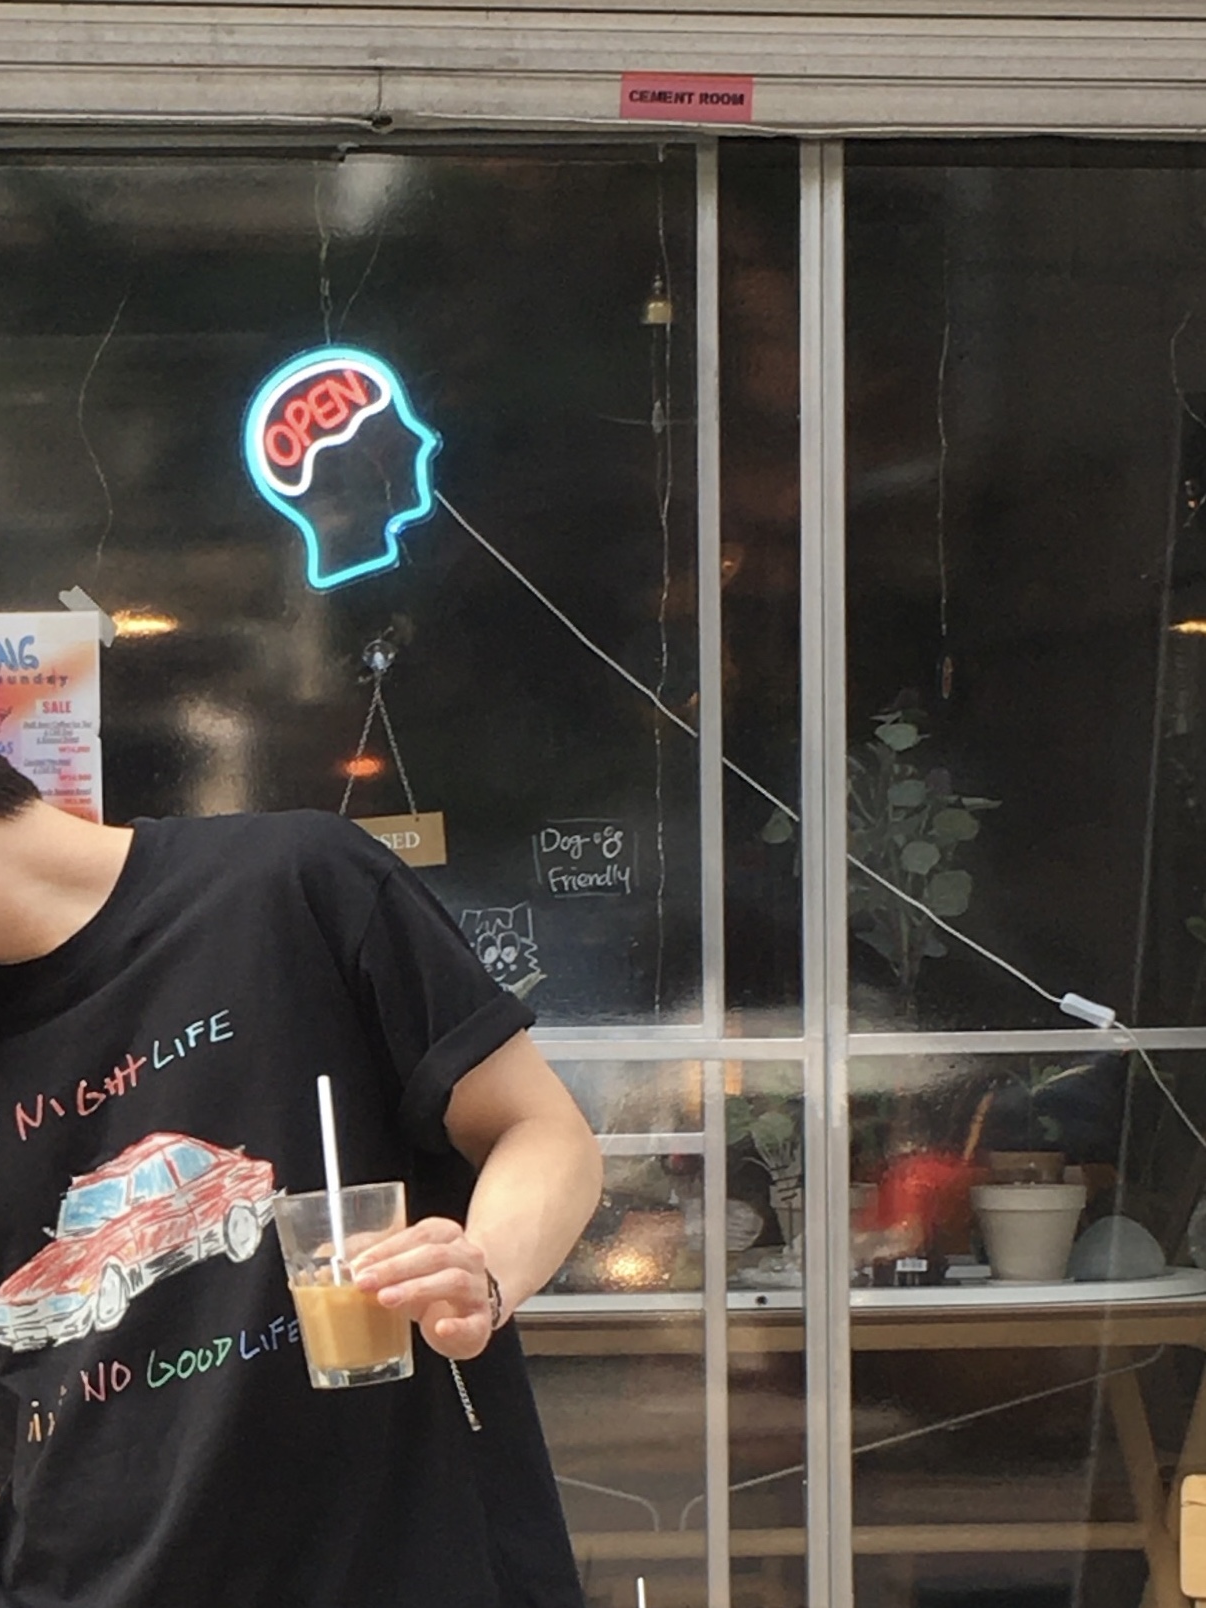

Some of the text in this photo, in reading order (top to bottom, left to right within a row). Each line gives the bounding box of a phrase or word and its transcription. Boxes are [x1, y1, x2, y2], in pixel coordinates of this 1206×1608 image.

[629, 90, 745, 106] CEMENT ROOM
[265, 368, 369, 467] OPEN
[42, 701, 72, 714] SALE
[541, 827, 591, 860] Dog
[548, 864, 631, 895] Friendly
[153, 1009, 234, 1069] LIFE
[81, 1315, 300, 1401] NO GOOD LIFE
